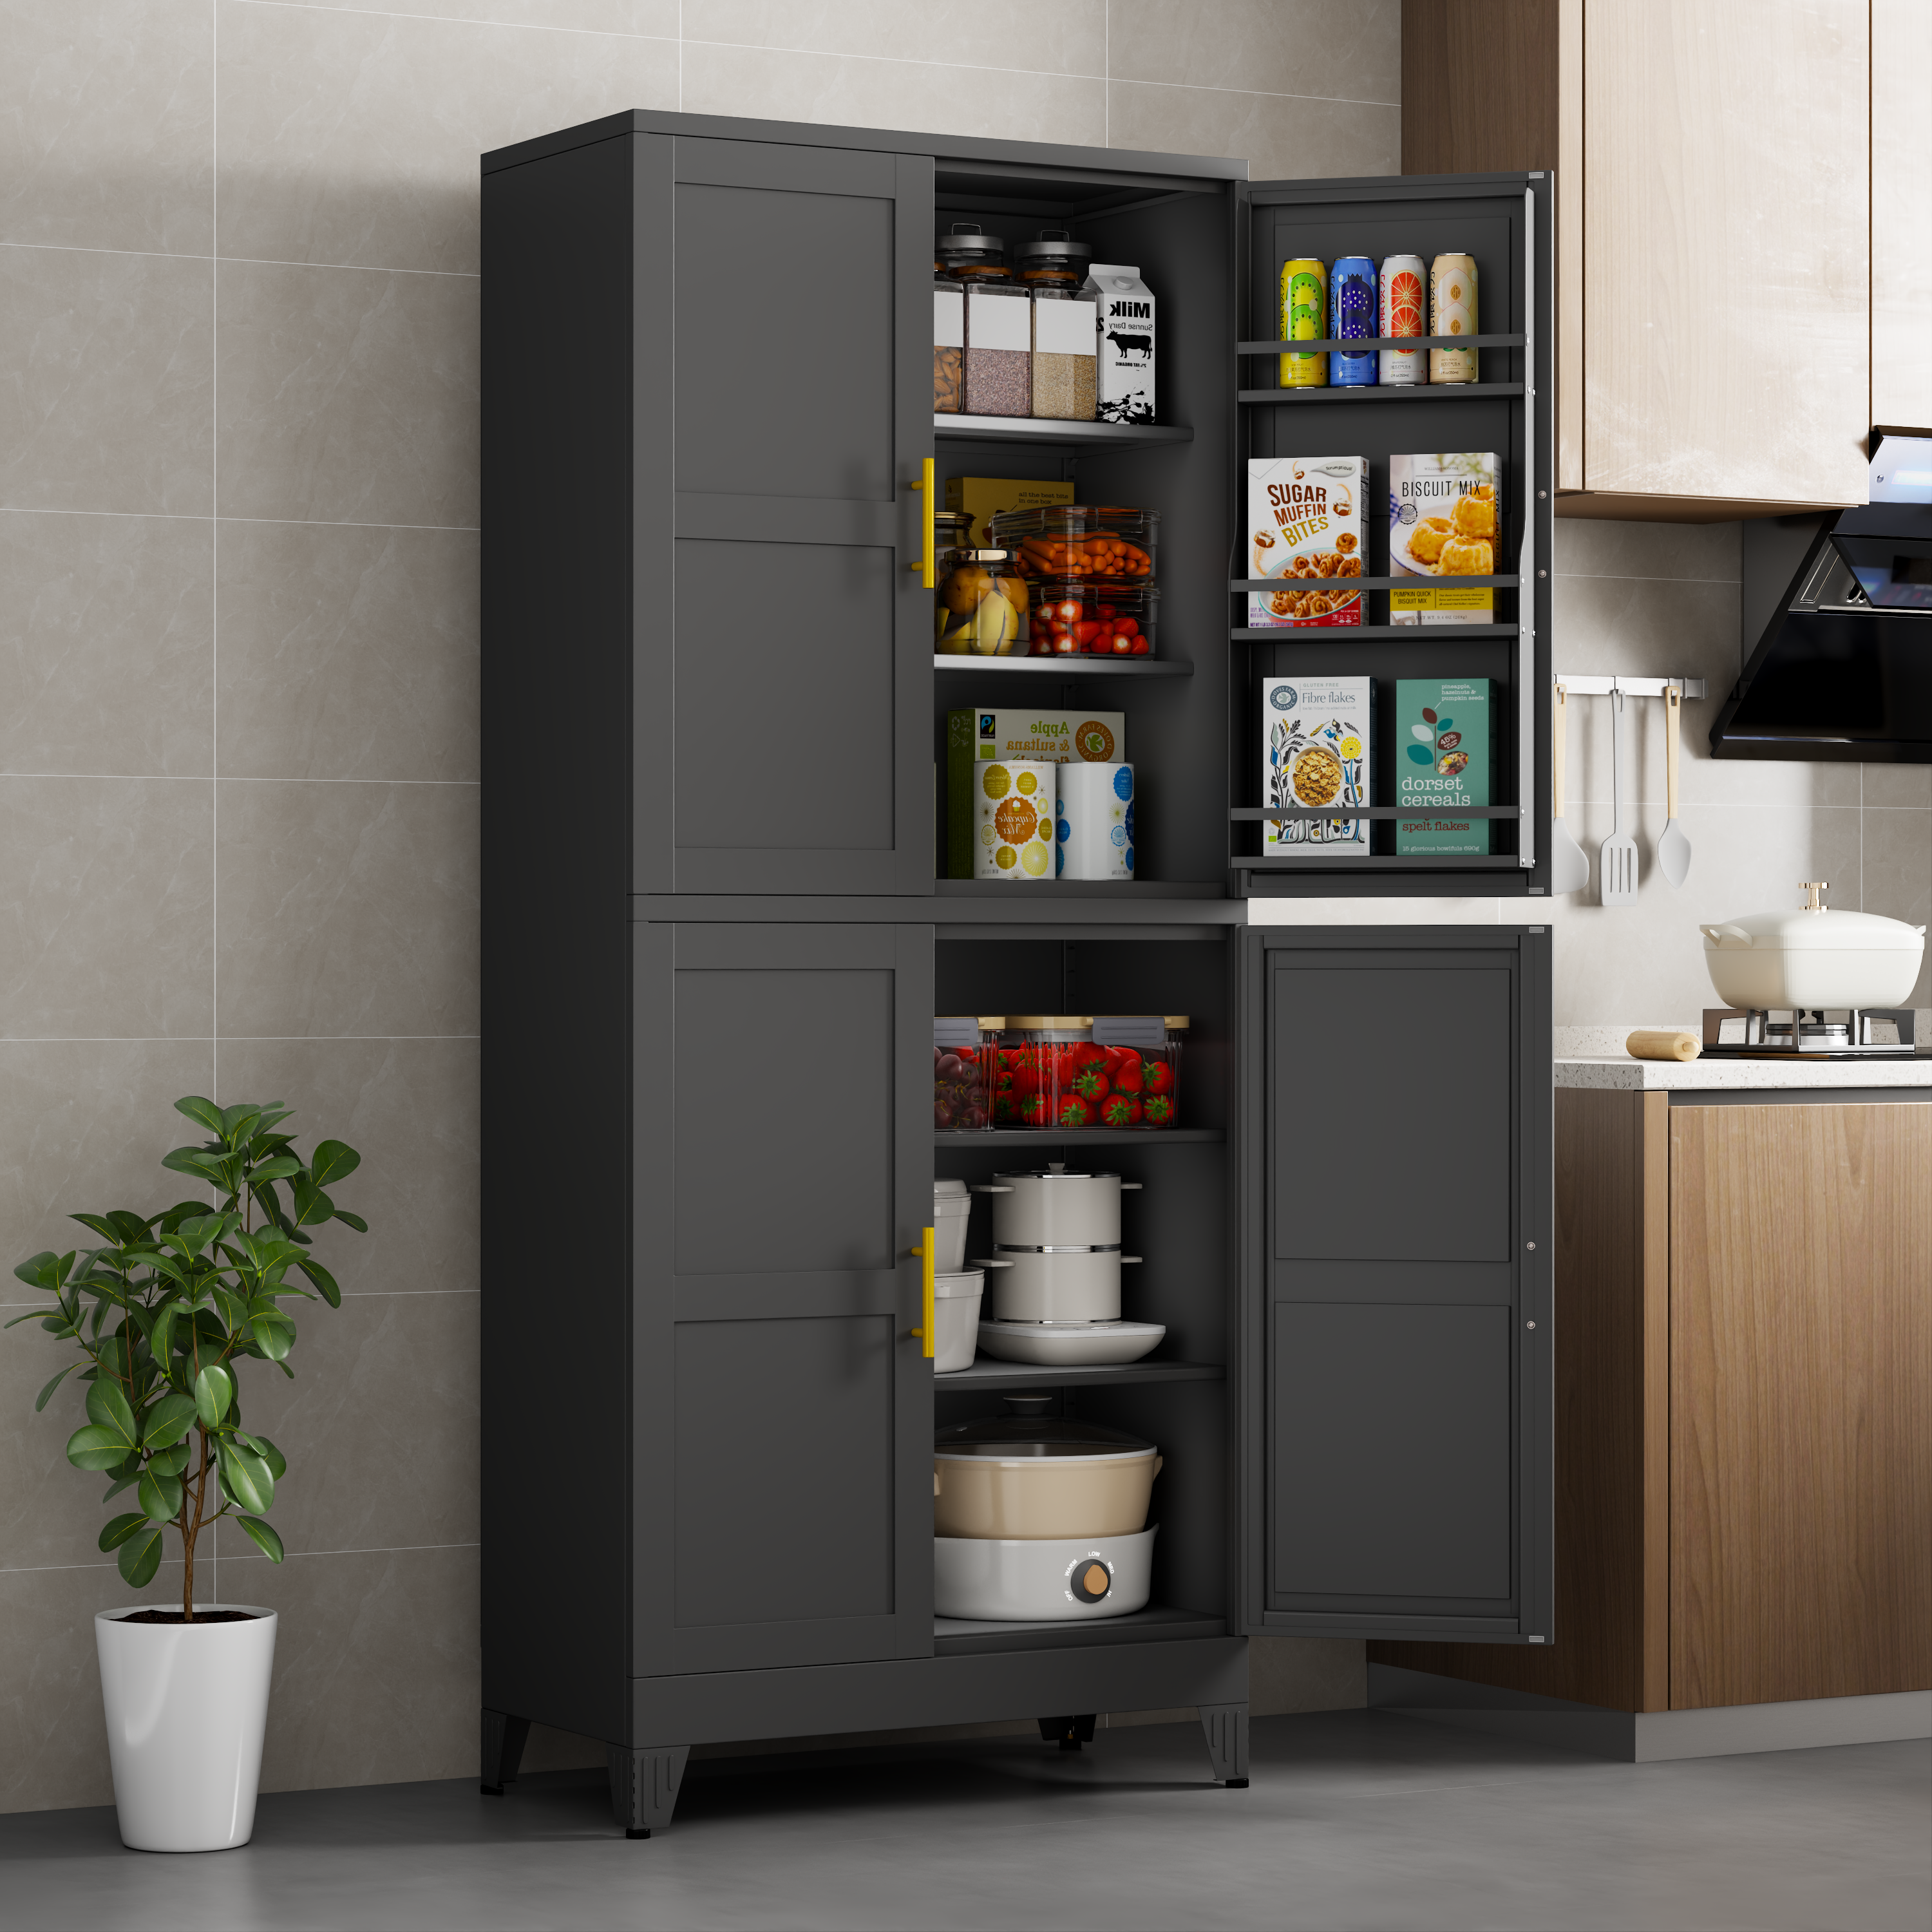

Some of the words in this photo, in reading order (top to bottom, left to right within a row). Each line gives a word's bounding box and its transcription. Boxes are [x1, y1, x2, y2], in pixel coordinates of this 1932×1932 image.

[1267, 484, 1327, 506] SUGAR
[1402, 481, 1452, 497] BISCUIT
[1459, 480, 1481, 496] MIX
[1273, 504, 1327, 527] MUFFIN
[1281, 516, 1329, 547] BITES
[1271, 687, 1285, 699] DOVES
[1285, 687, 1296, 699] FARM
[1302, 692, 1326, 703] Fibre
[1329, 691, 1356, 703] flakes
[1273, 700, 1295, 710] ORGANIC
[1441, 733, 1456, 745] 45%
[1401, 776, 1463, 791] dorset
[1401, 792, 1471, 806] cereals
[1402, 821, 1432, 833] spelt
[1434, 821, 1470, 831] flakes
[1064, 1558, 1078, 1577] WARM
[1064, 1590, 1074, 1602] OFF
